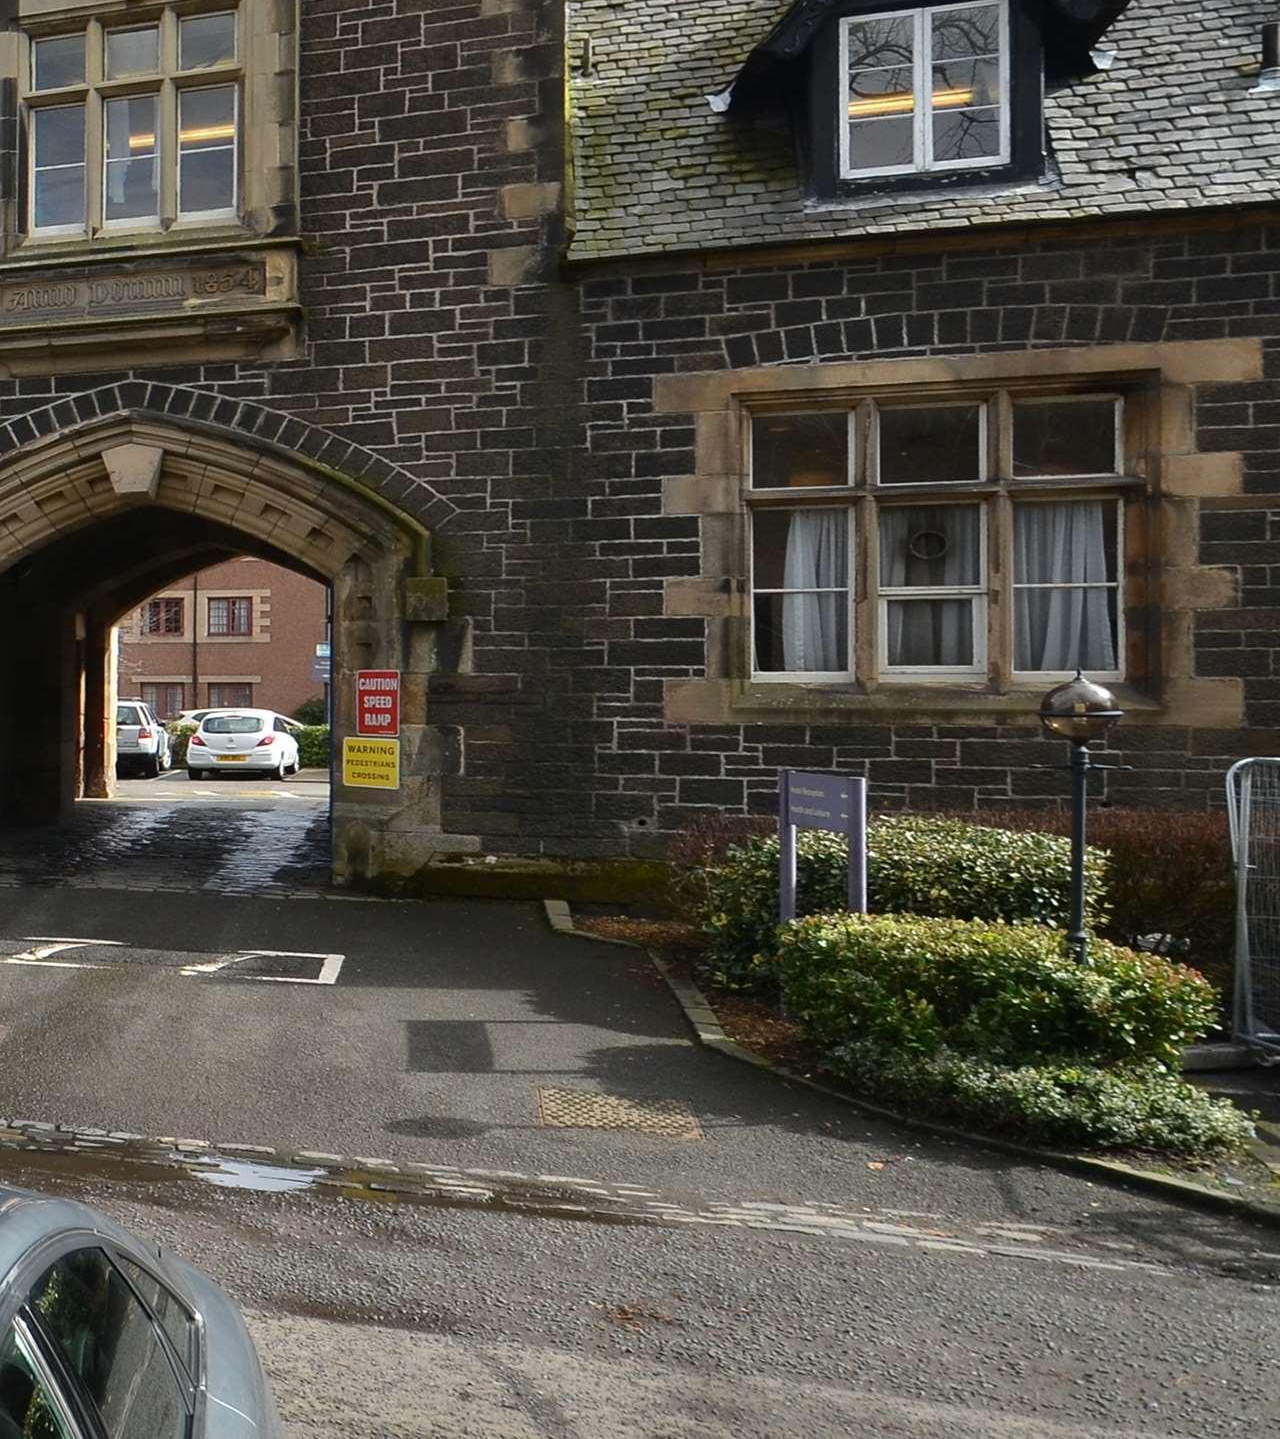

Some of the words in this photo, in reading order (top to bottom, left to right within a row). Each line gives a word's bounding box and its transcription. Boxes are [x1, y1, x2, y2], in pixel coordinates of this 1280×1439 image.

[6, 283, 77, 312] Anno
[191, 267, 260, 295] 1854
[359, 678, 398, 691] CAUTION
[363, 696, 393, 709] SPEED
[364, 713, 392, 727] RAMP
[347, 744, 395, 756] WARNING
[346, 758, 396, 769] PEDESTRIANS
[351, 771, 390, 781] CROSSING
